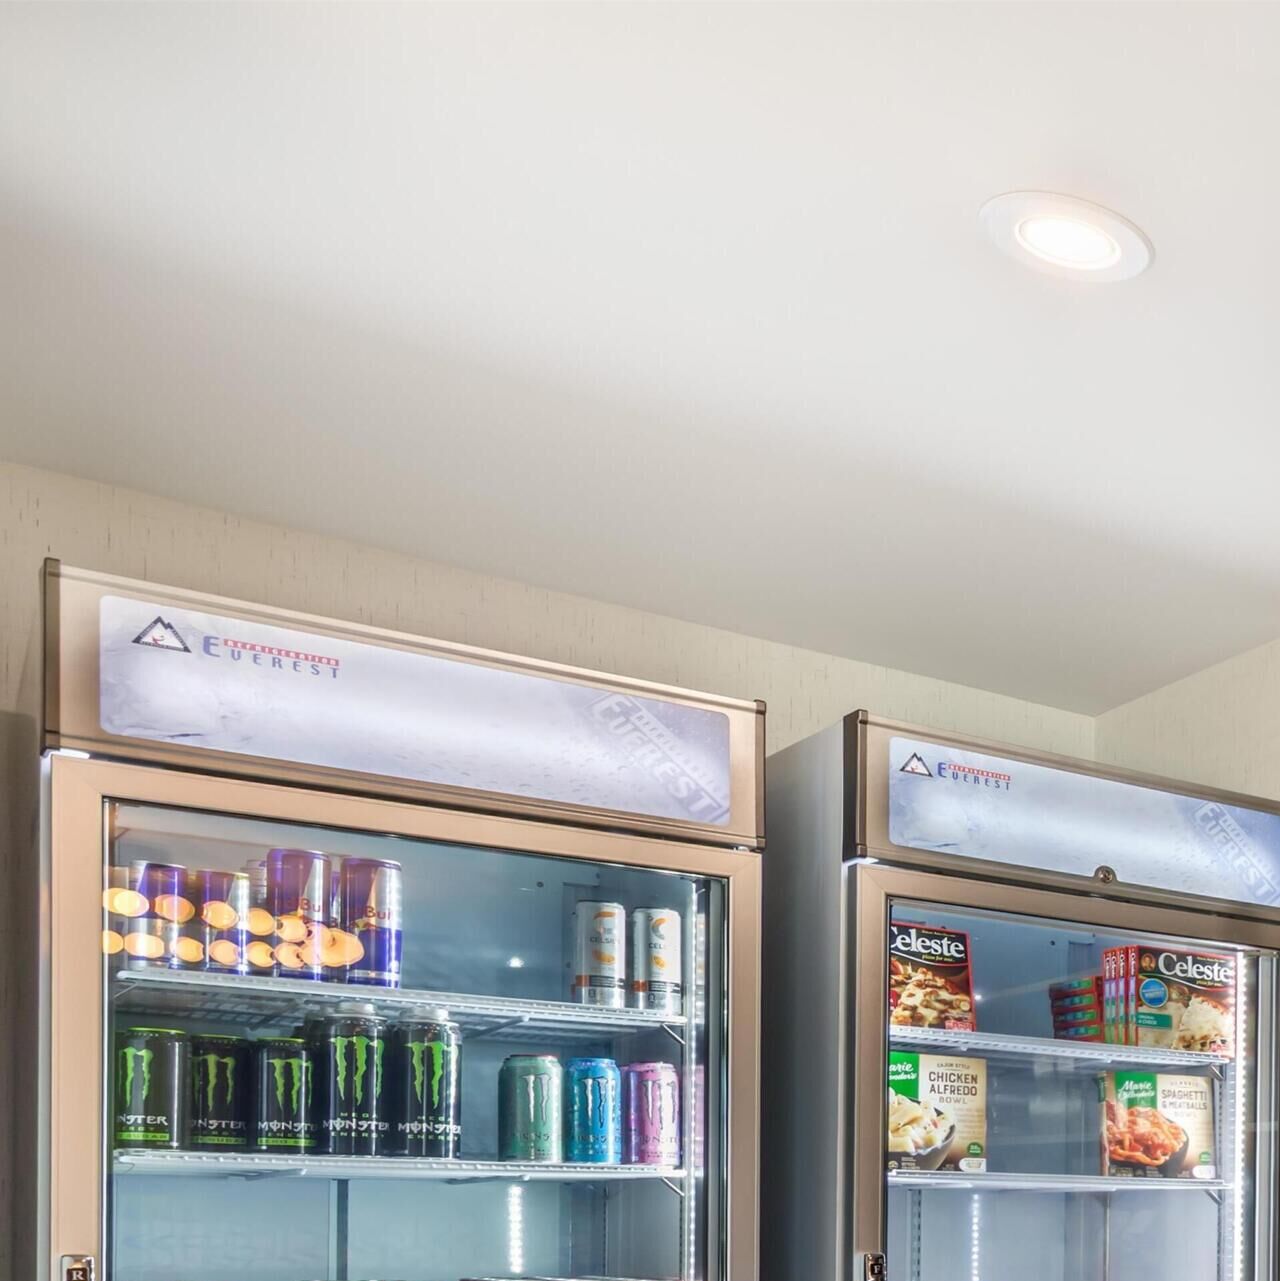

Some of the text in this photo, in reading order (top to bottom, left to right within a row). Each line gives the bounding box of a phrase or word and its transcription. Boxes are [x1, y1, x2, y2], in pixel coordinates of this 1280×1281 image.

[1158, 952, 1232, 982] Celeste
[929, 1072, 978, 1084] CHICKEN
[929, 1085, 978, 1096] ALFREDO
[1161, 1089, 1208, 1101] SPAGHETTI
[1169, 1102, 1208, 1110] MEATBALLS
[71, 1270, 84, 1281] R
